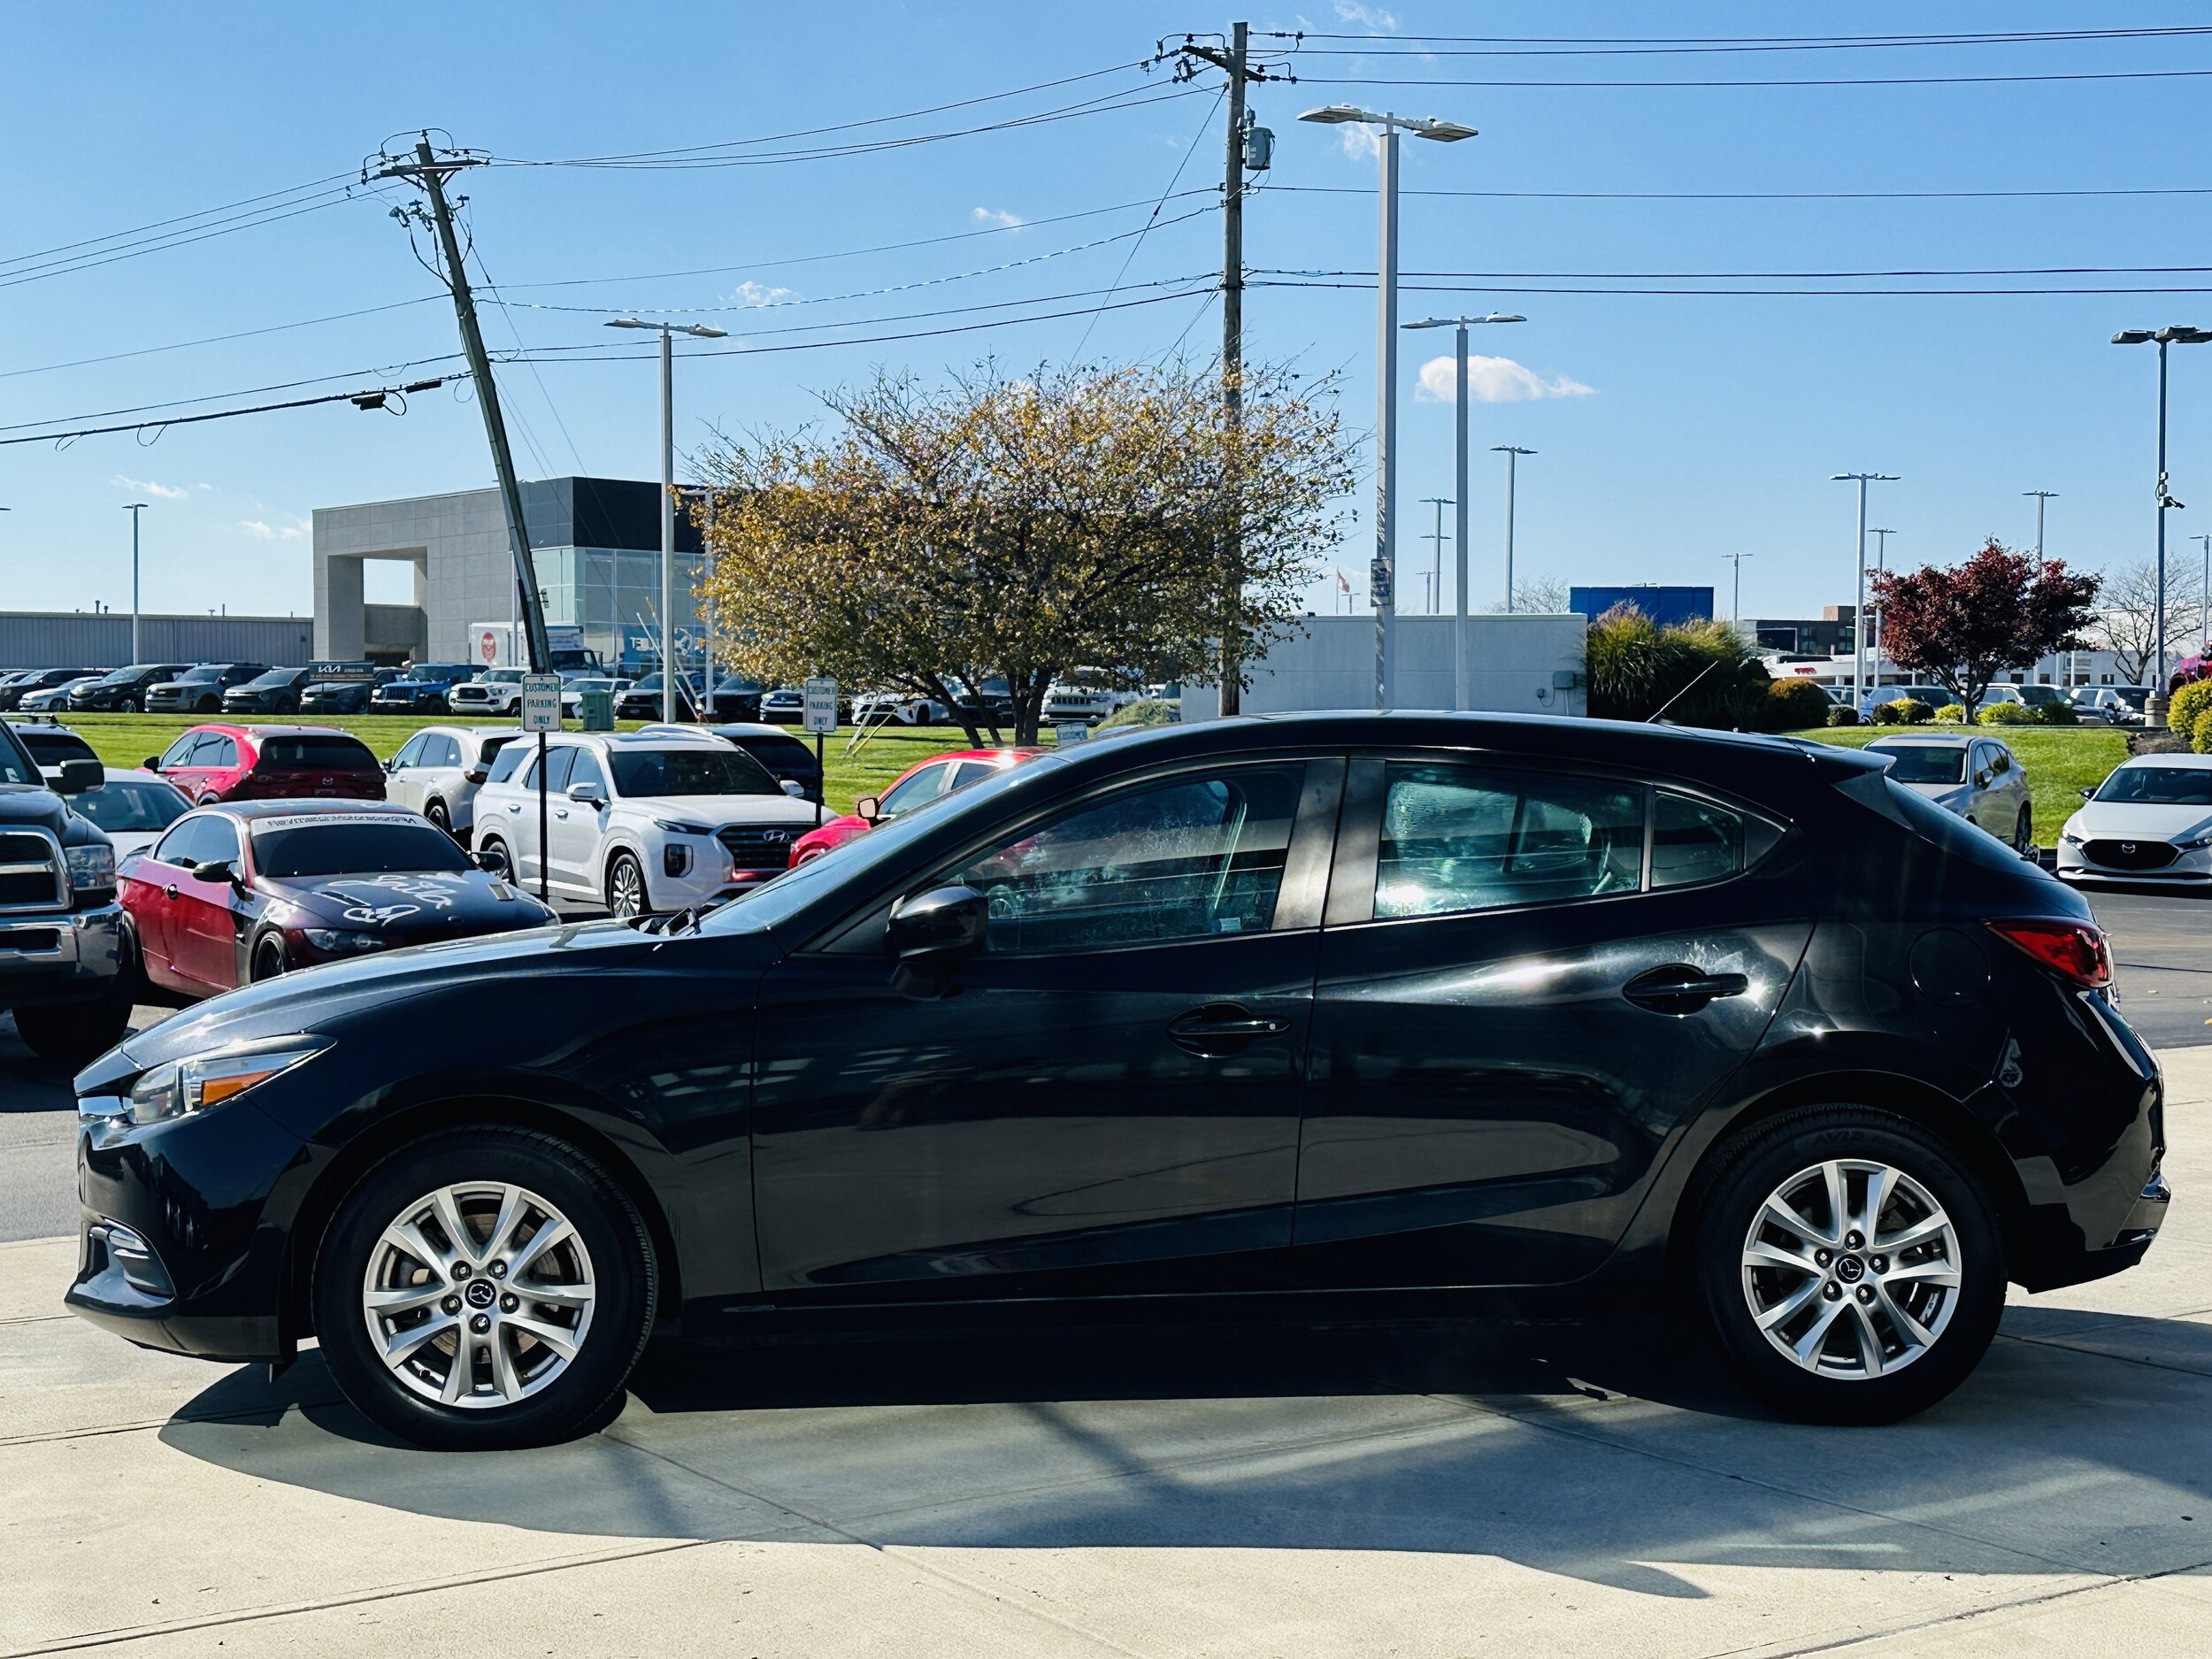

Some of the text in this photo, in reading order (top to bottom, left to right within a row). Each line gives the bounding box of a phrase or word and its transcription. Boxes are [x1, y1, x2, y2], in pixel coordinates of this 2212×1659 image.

[524, 683, 559, 692] CUSTOMER
[527, 699, 557, 708] PARKING
[533, 715, 550, 725] ONLY
